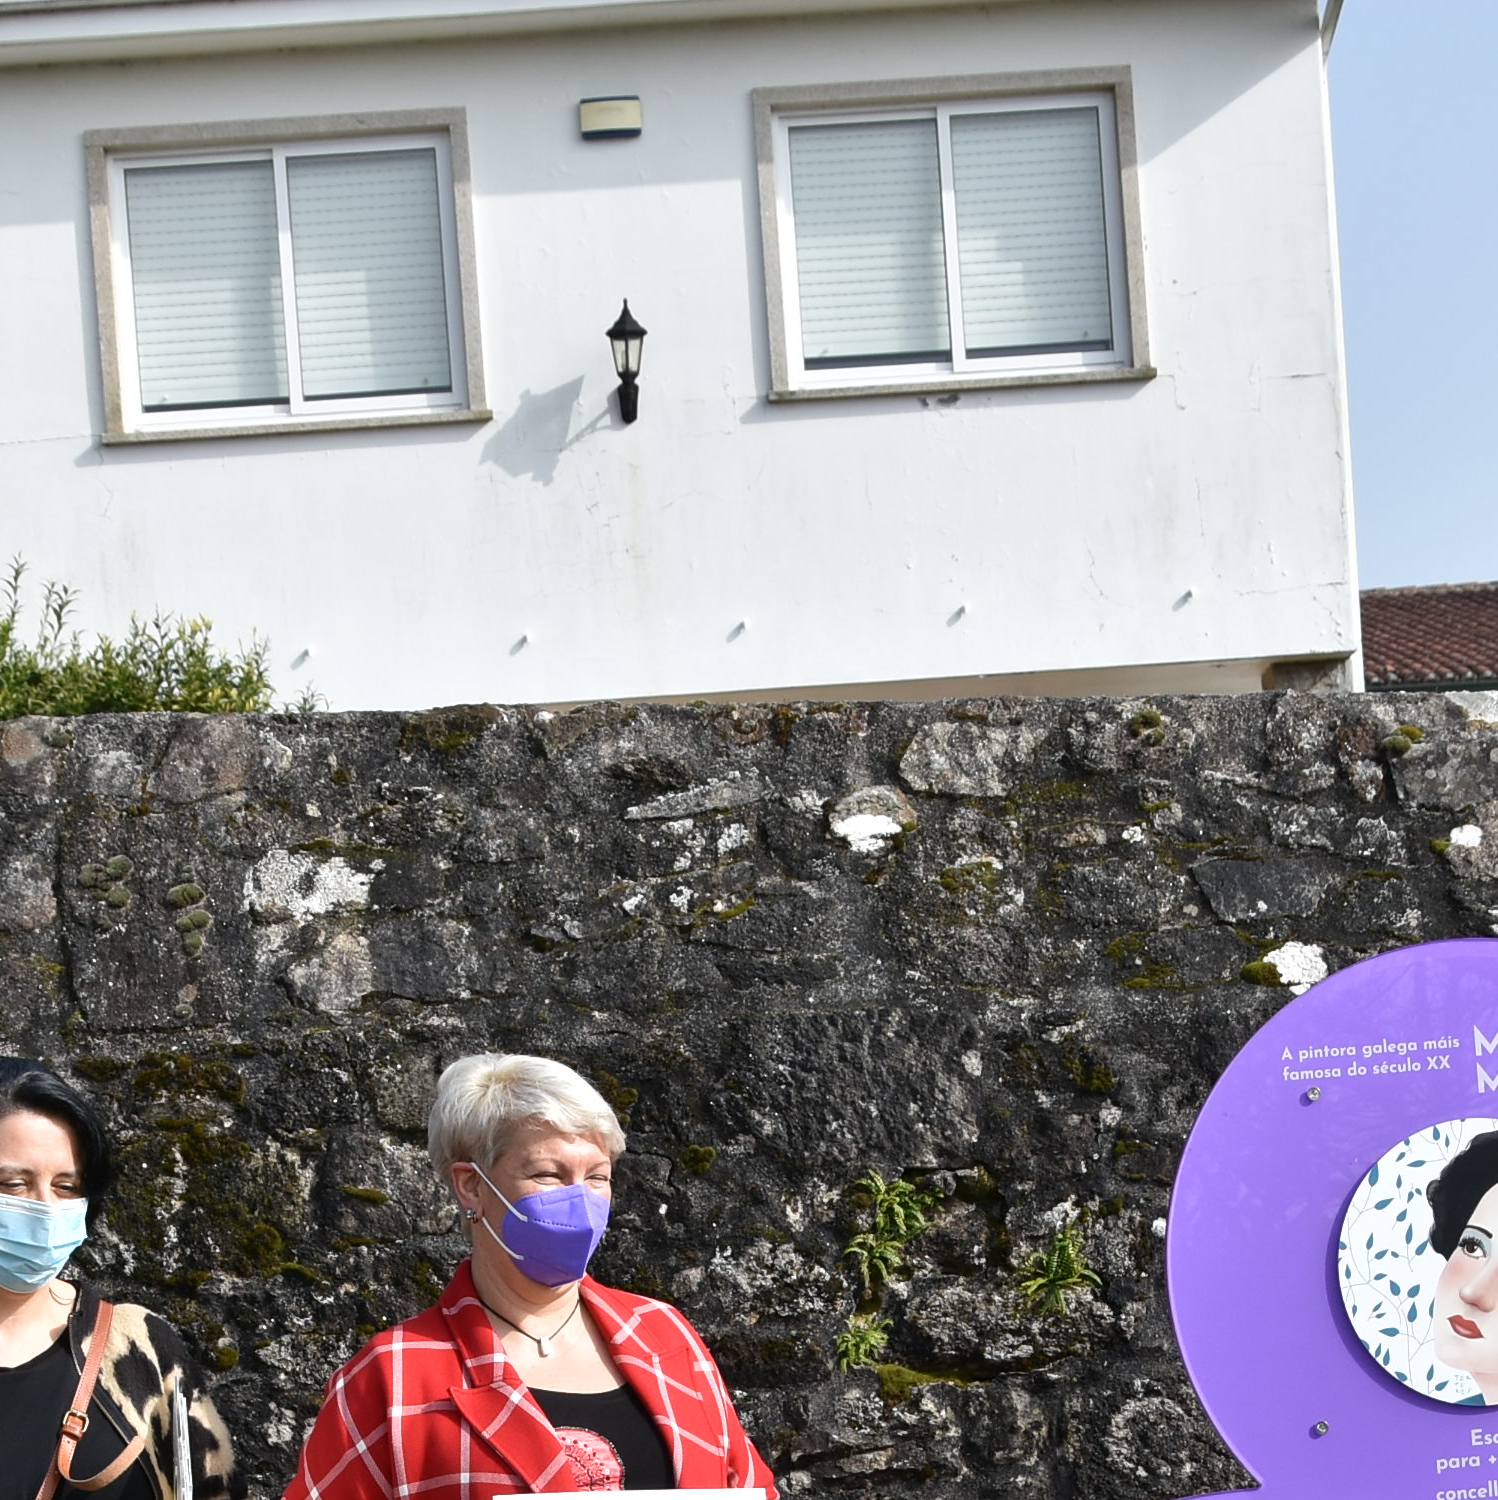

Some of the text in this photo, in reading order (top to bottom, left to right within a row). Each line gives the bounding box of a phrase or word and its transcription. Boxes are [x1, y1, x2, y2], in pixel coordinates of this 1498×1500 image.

[1282, 1036, 1459, 1062] A pintora galega máis
[1283, 1055, 1450, 1080] famosa do século XX
[1437, 1456, 1480, 1474] para
